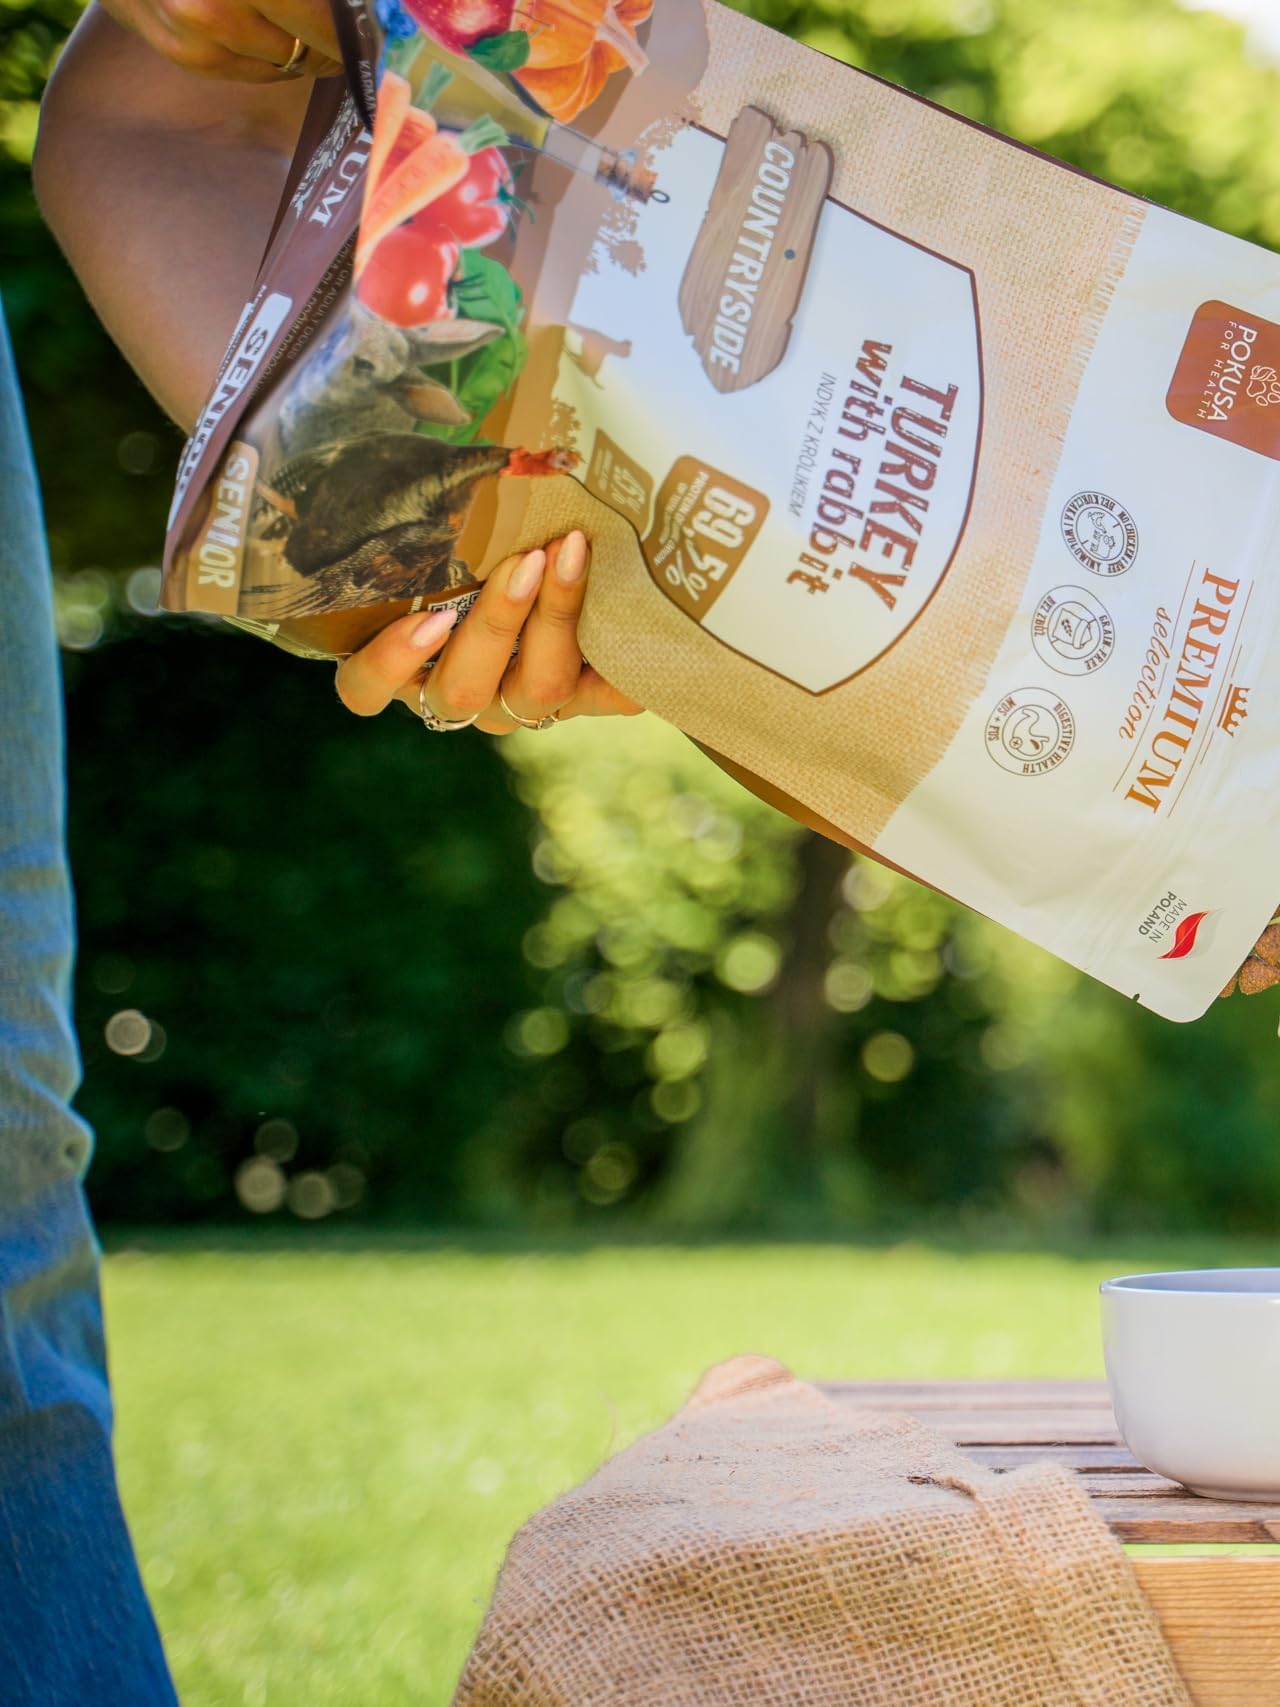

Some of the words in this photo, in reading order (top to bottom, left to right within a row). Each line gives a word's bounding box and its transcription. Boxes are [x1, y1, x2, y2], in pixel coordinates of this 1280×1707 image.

[710, 141, 795, 375] COUNTRYSIDE
[1220, 320, 1237, 350] FOR
[837, 340, 893, 441] with
[1196, 359, 1224, 419] HEALTH
[1207, 325, 1258, 420] POKUSA
[809, 372, 837, 421] INDYK
[807, 420, 824, 434] Z
[788, 434, 821, 518] KRÓLIKIEM
[848, 376, 959, 611] TURKEY
[198, 454, 249, 589] SENIOR
[786, 448, 864, 595] rabbit
[1063, 494, 1099, 521] KURCZAKA
[1100, 496, 1116, 511] BEZ
[1117, 511, 1130, 524] NO
[1123, 523, 1136, 560] CHICKEN
[1107, 560, 1126, 574] BEEF
[1040, 595, 1056, 613] BEZ
[1084, 614, 1113, 671] GRAIN-FREE
[1119, 607, 1172, 740] selection
[1124, 567, 1240, 814] PREMIUM
[997, 696, 1017, 717] MOS
[1053, 702, 1073, 753] DIGESTIVE
[988, 725, 1000, 742] FOS
[1022, 751, 1062, 774] HEALTH
[1138, 891, 1177, 936] POLAND
[1148, 929, 1164, 943] IN
[1159, 899, 1188, 931] MADE
